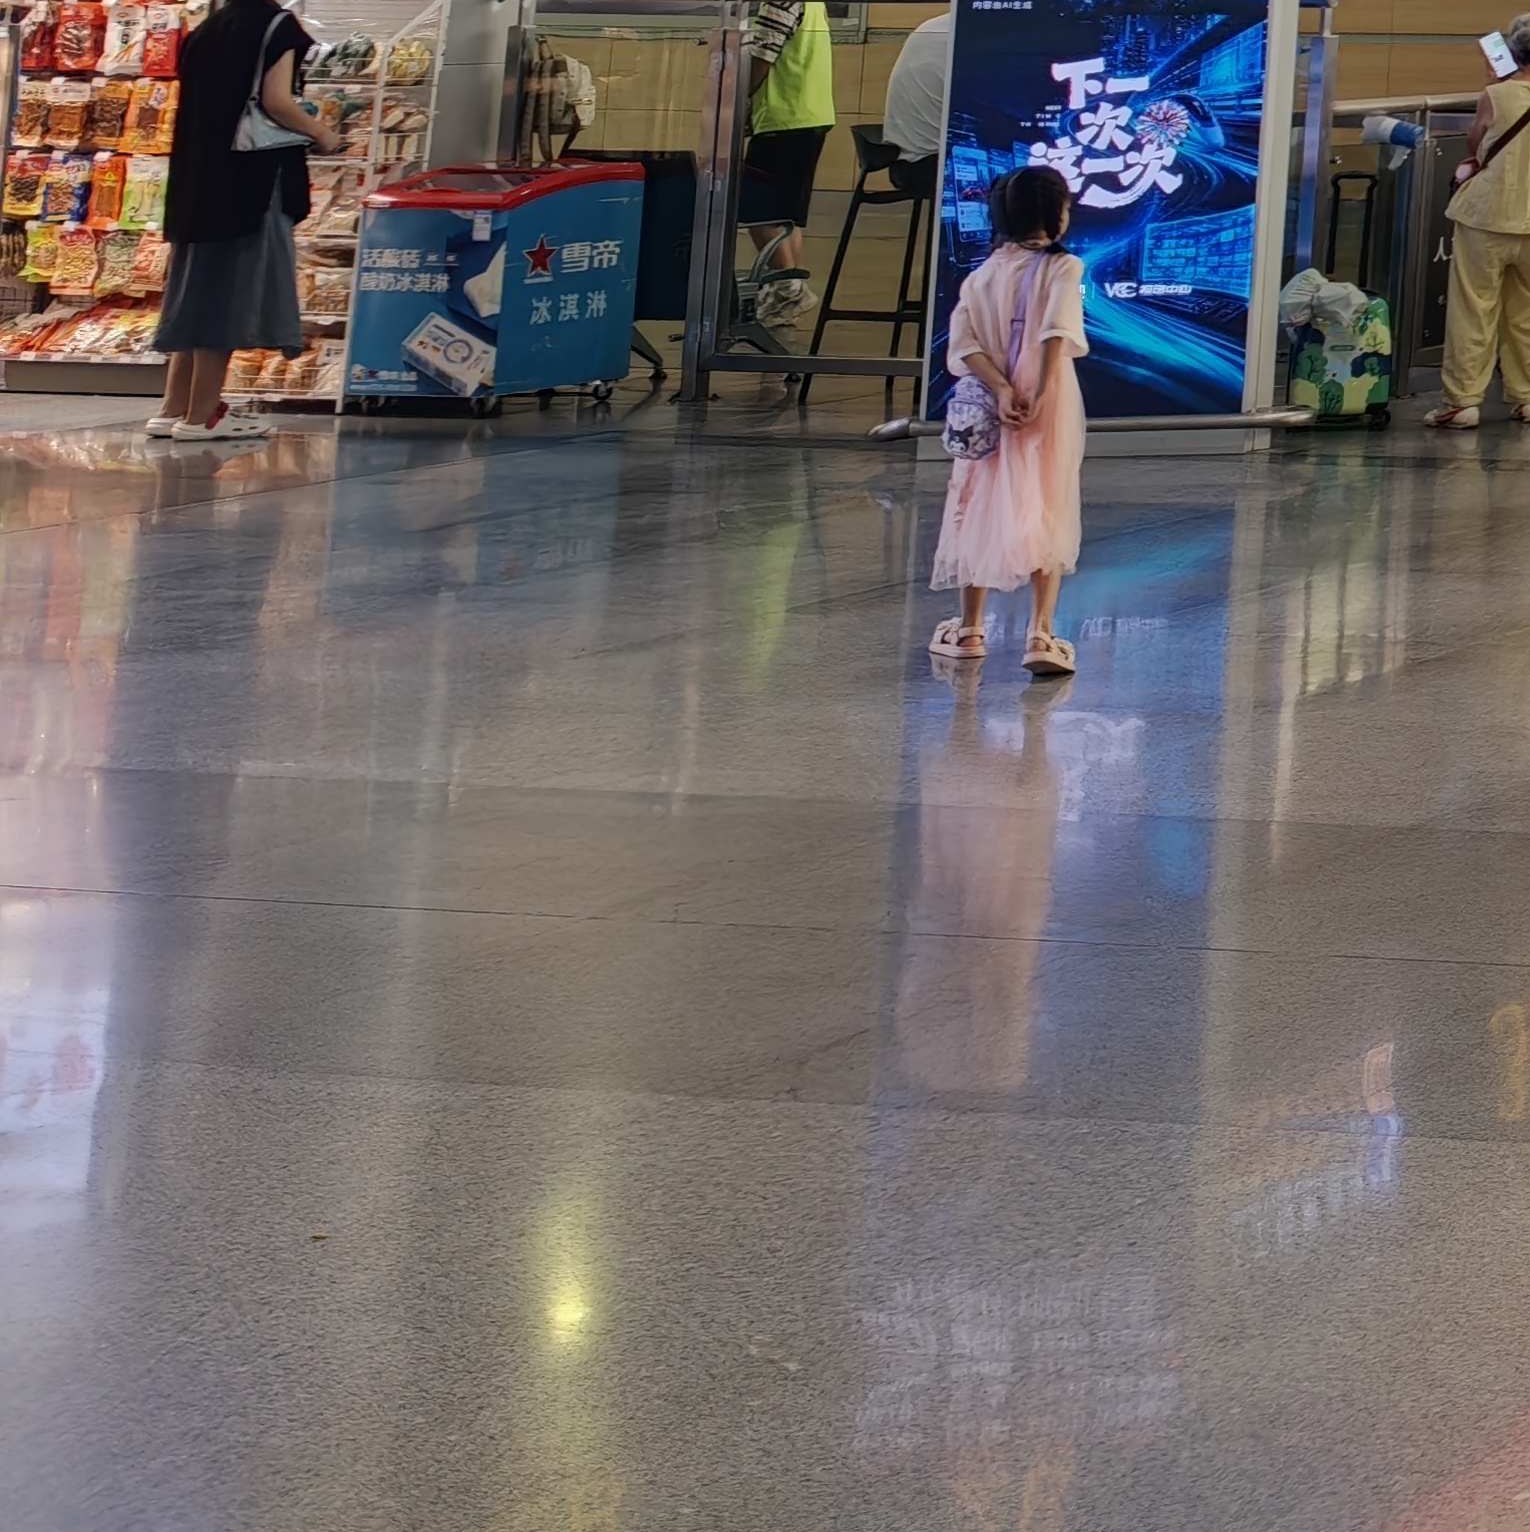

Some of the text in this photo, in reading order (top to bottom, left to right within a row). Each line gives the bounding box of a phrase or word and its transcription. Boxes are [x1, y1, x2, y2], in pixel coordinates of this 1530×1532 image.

[560, 239, 624, 273] 雪帝
[529, 290, 607, 326] 冰淇淋
